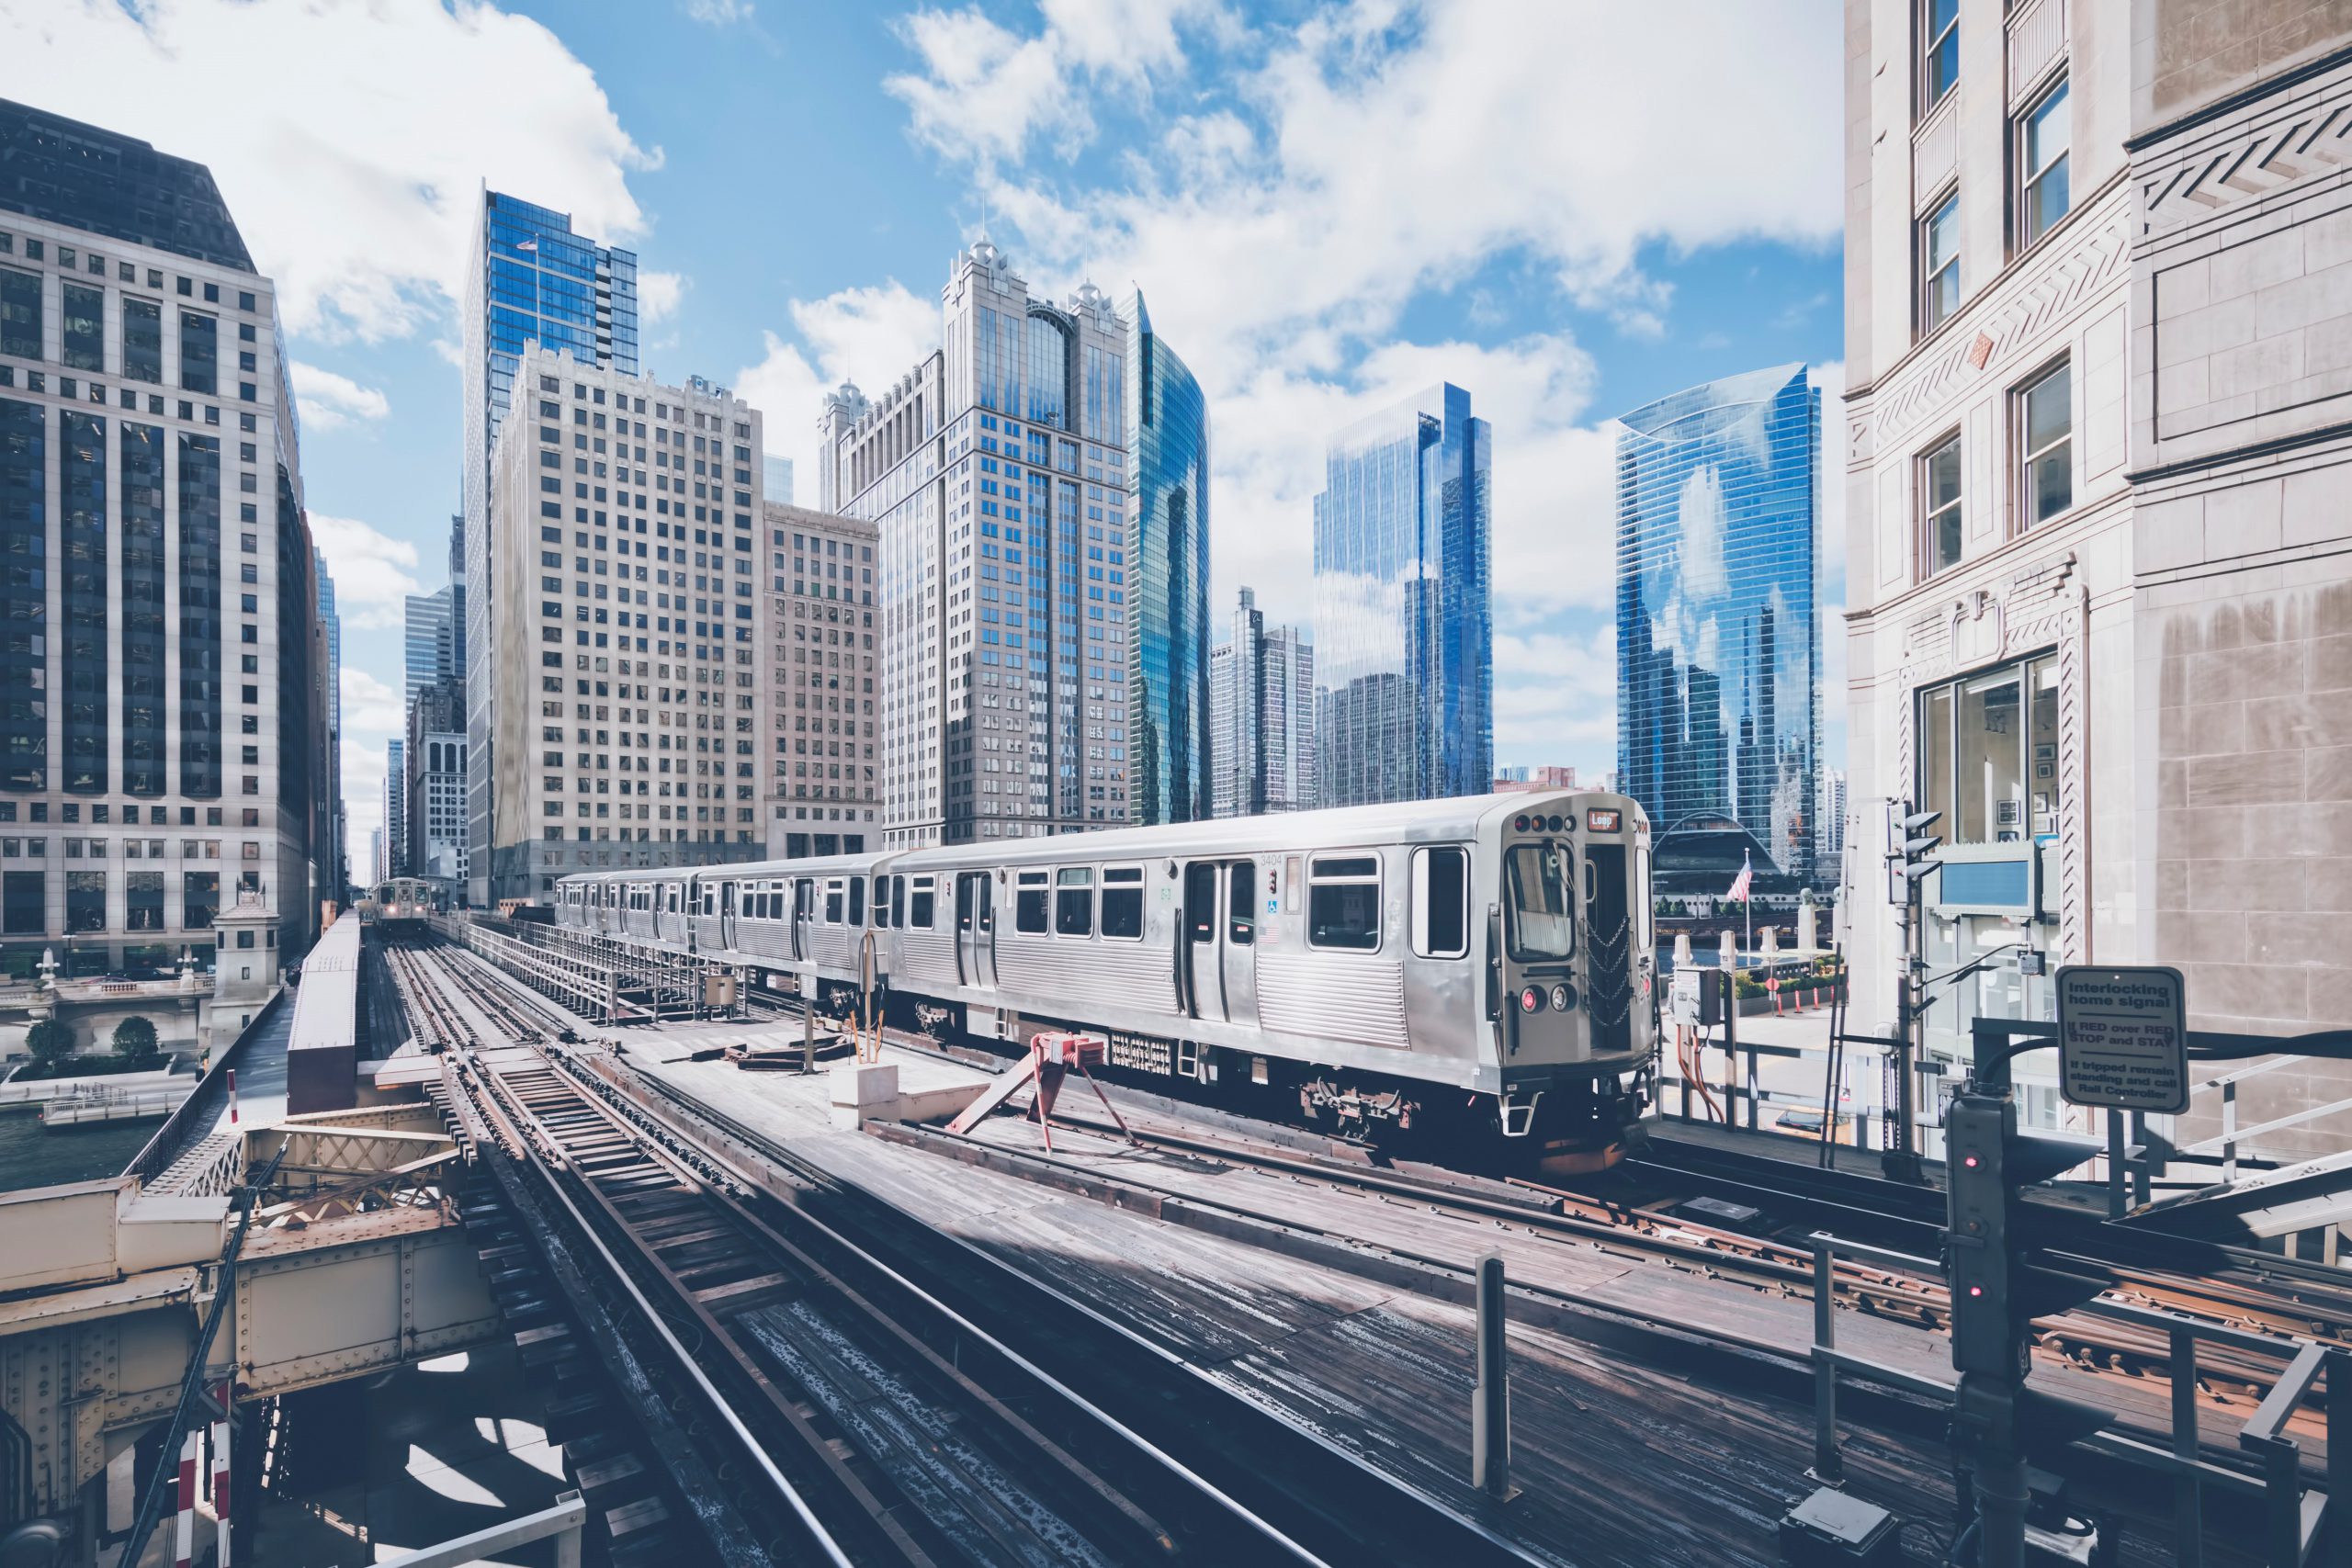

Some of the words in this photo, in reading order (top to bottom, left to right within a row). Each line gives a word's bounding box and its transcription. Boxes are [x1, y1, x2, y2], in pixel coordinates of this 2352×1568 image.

[1592, 813, 1611, 828] Loop
[1261, 854, 1282, 866] 3404
[2069, 982, 2168, 998] Interlocking
[2069, 994, 2112, 1006] home
[2119, 997, 2170, 1009] signal
[2080, 1022, 2107, 1032] RED
[2111, 1025, 2140, 1033] over
[2144, 1025, 2175, 1035] RED
[2069, 1033, 2104, 1043] STOP
[2109, 1036, 2132, 1045] and
[2138, 1038, 2172, 1047] STAY
[2071, 1060, 2078, 1068] If
[2082, 1061, 2126, 1073] tripped
[2131, 1066, 2175, 1076] remain
[2071, 1073, 2122, 1086] standing
[2127, 1077, 2150, 1086] and
[2154, 1079, 2177, 1089] call
[2078, 1084, 2101, 1093] Rail
[2105, 1086, 2167, 1100] Controller
